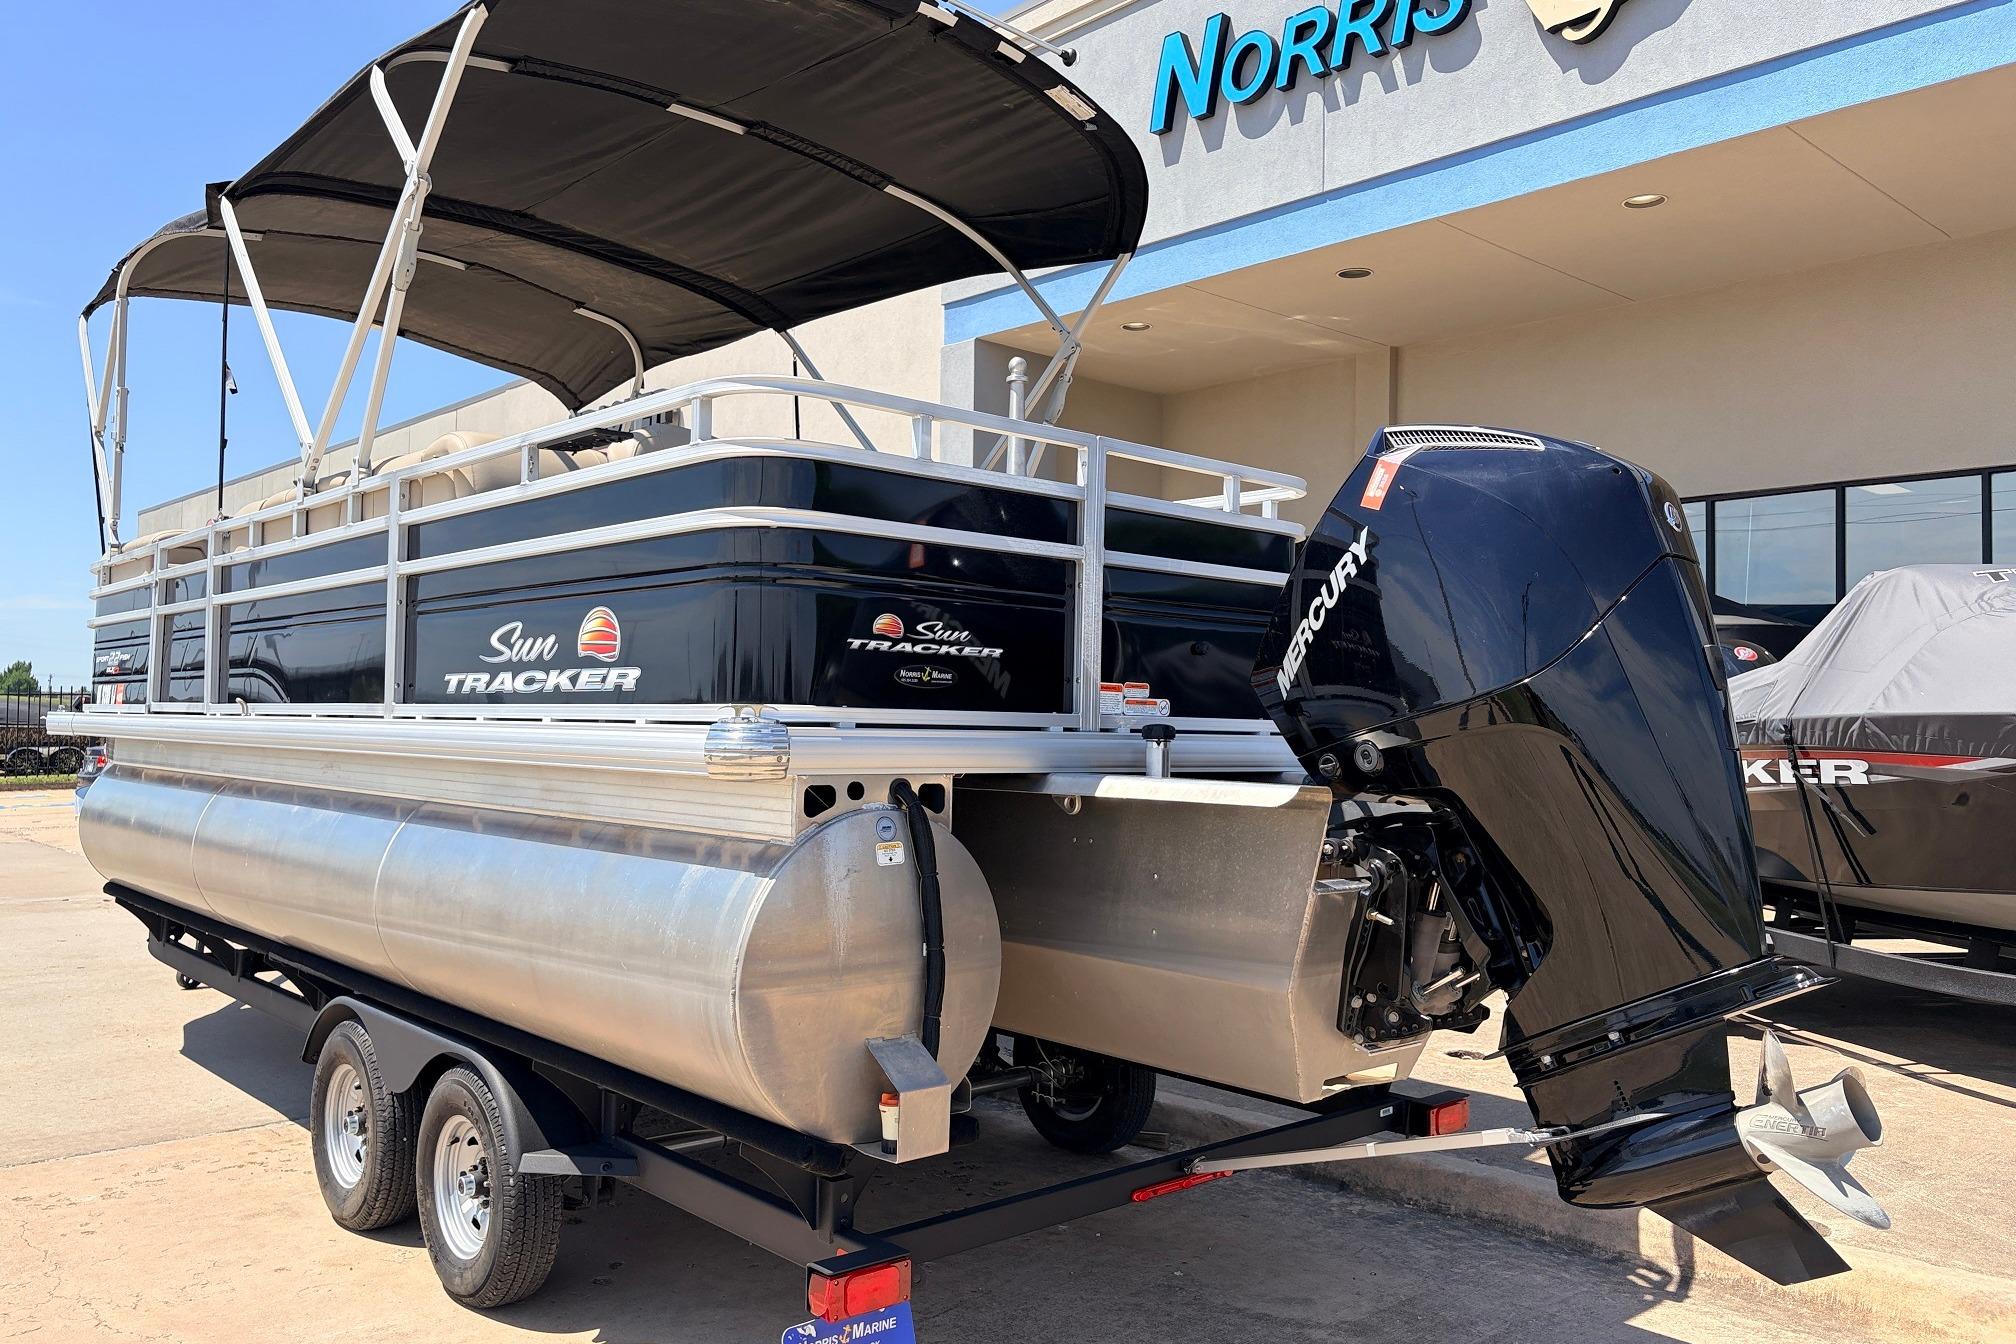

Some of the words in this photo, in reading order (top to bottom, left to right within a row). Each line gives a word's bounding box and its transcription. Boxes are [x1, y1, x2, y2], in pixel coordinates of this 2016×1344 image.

[1277, 526, 1368, 701] MERCURY
[478, 620, 559, 664] Sun
[906, 621, 972, 643] Sun
[846, 638, 1004, 658] TRACKER
[443, 666, 642, 694] TRACKER
[1749, 1114, 1827, 1137] ENERTIA
[852, 1316, 897, 1340] MARINE
